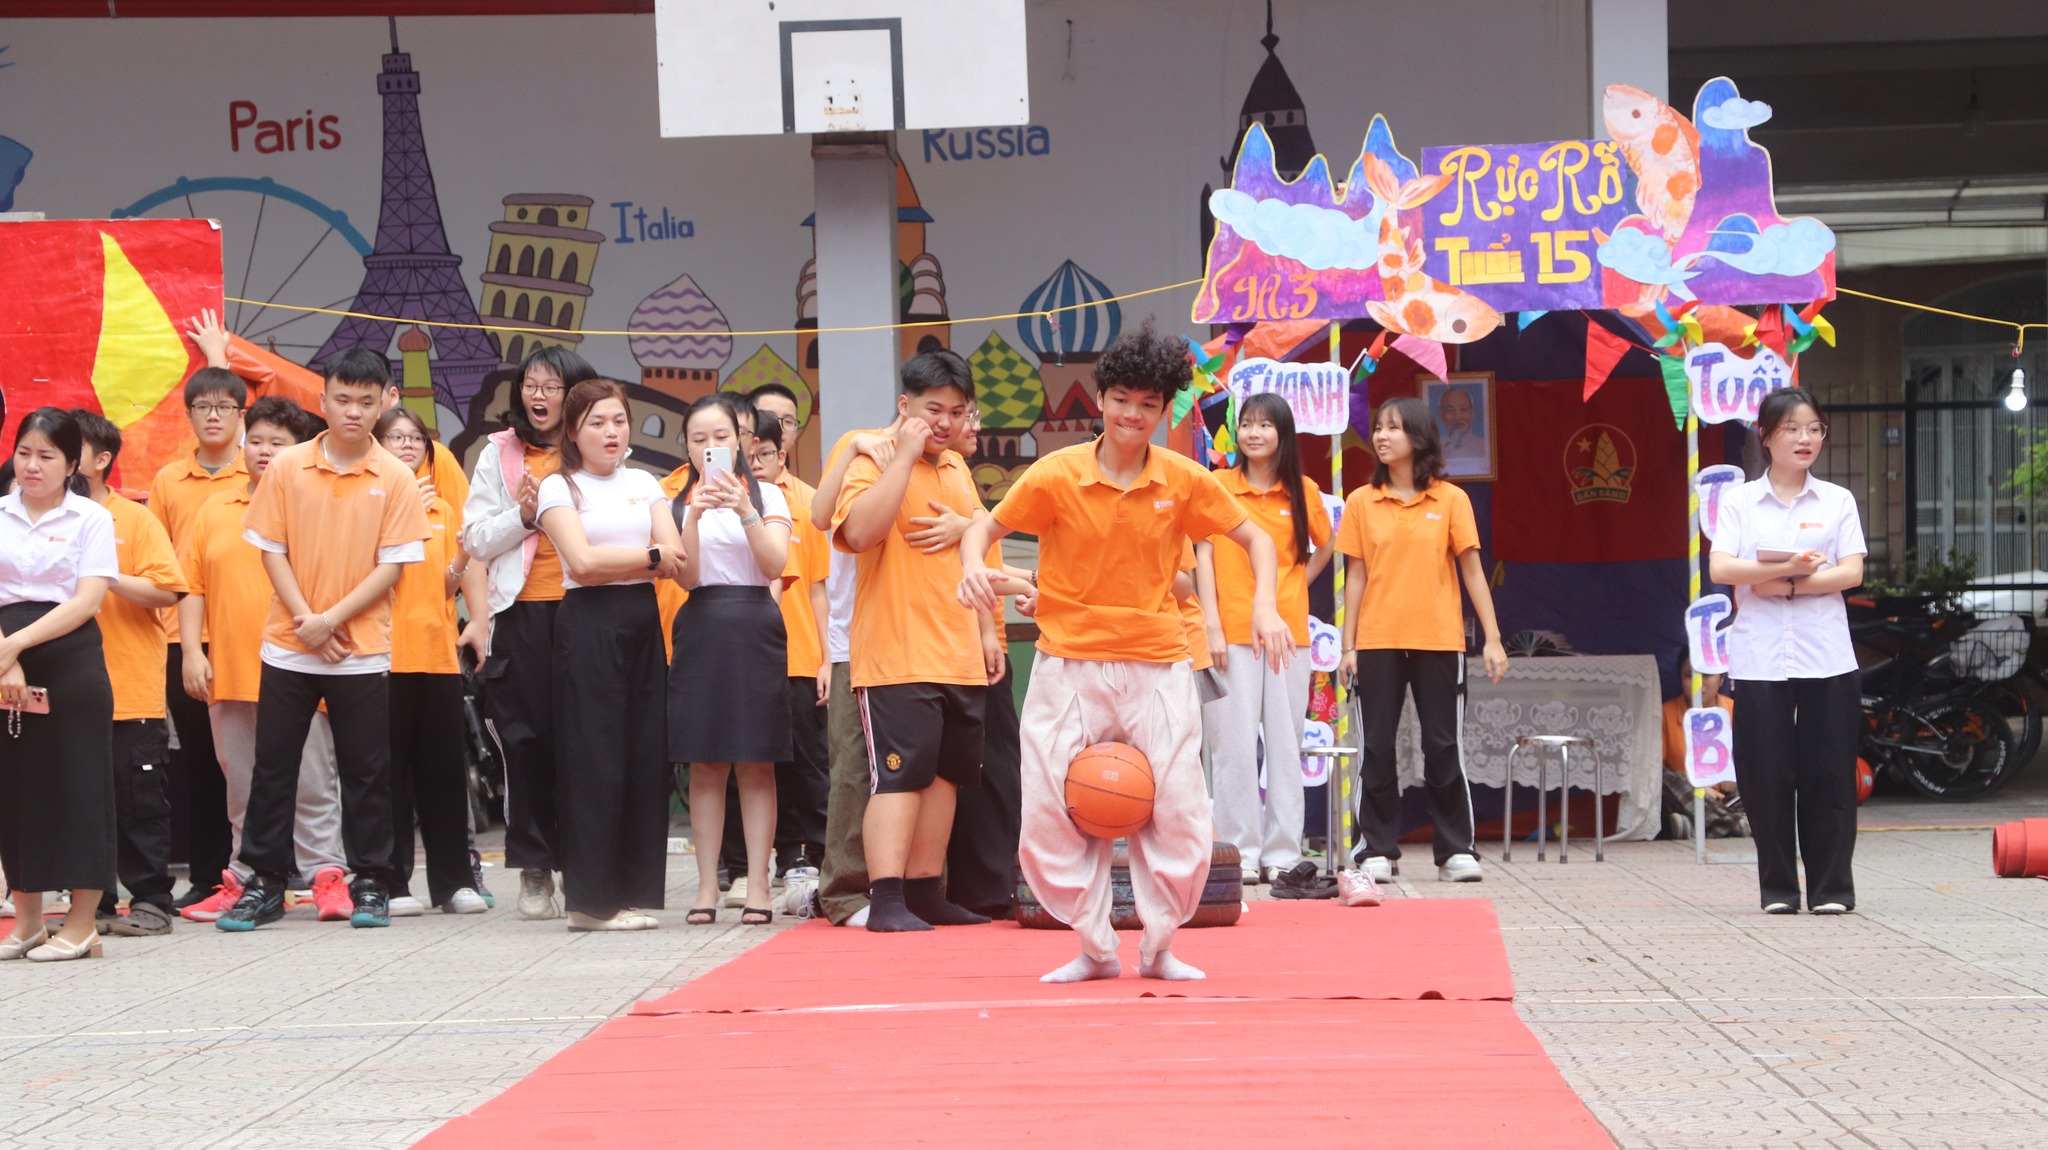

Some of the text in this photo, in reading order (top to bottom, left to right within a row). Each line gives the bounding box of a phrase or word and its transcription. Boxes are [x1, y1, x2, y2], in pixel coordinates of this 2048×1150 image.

[229, 100, 342, 154] Paris
[923, 125, 1050, 163] Russia
[1439, 146, 1539, 226] Rực
[610, 202, 695, 244] Italia
[1434, 230, 1592, 286] Tuổi 15
[1700, 471, 1735, 535] T
[1690, 601, 1729, 668] T
[1691, 712, 1729, 780] B
